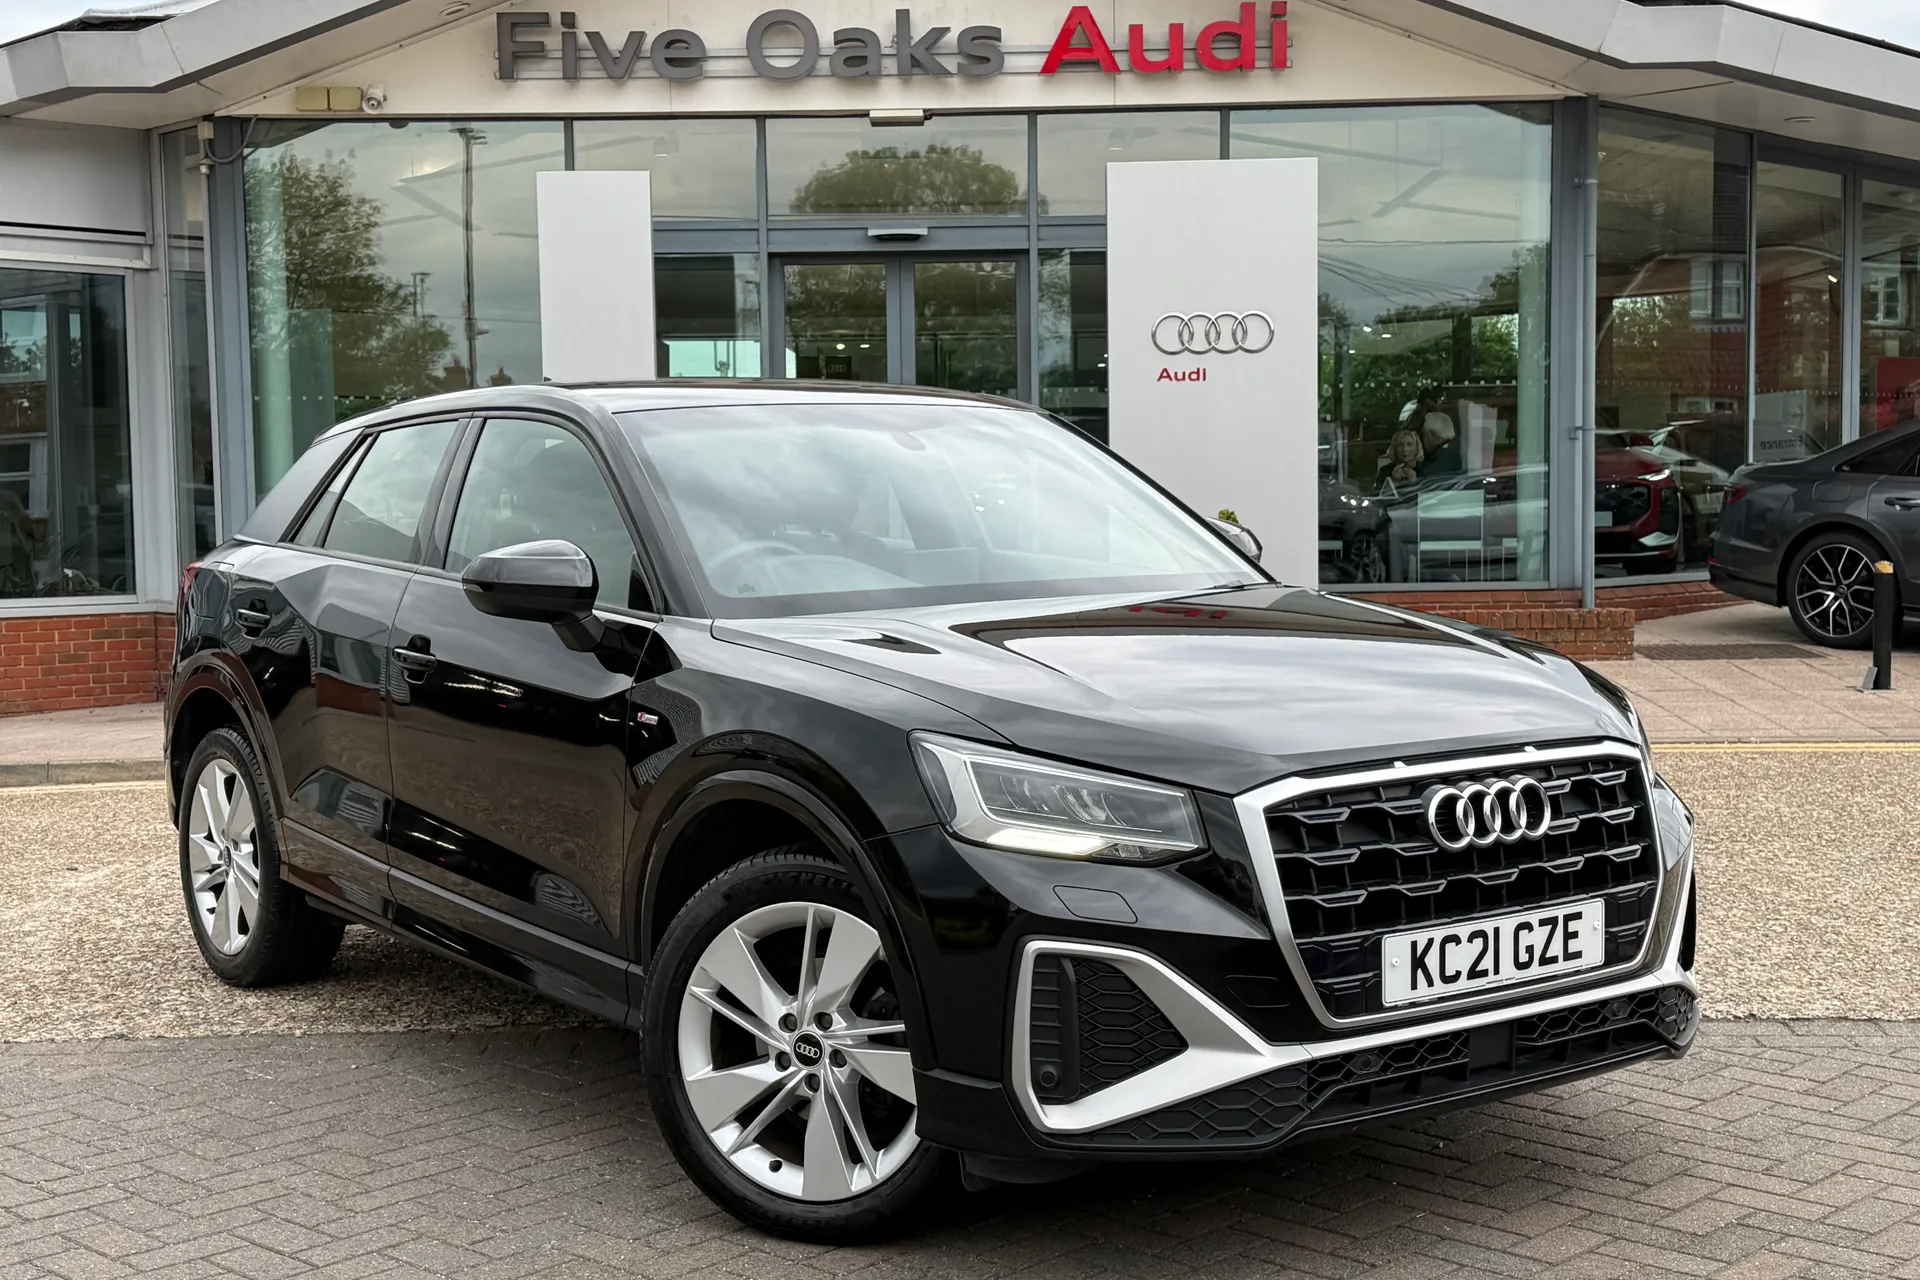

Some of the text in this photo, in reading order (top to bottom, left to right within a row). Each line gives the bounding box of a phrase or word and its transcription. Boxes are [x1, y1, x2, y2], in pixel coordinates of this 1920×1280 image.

[496, 1, 1289, 82] Five Oaks Audi
[1157, 367, 1207, 382] Audi
[1410, 911, 1583, 991] KC21 GZE
